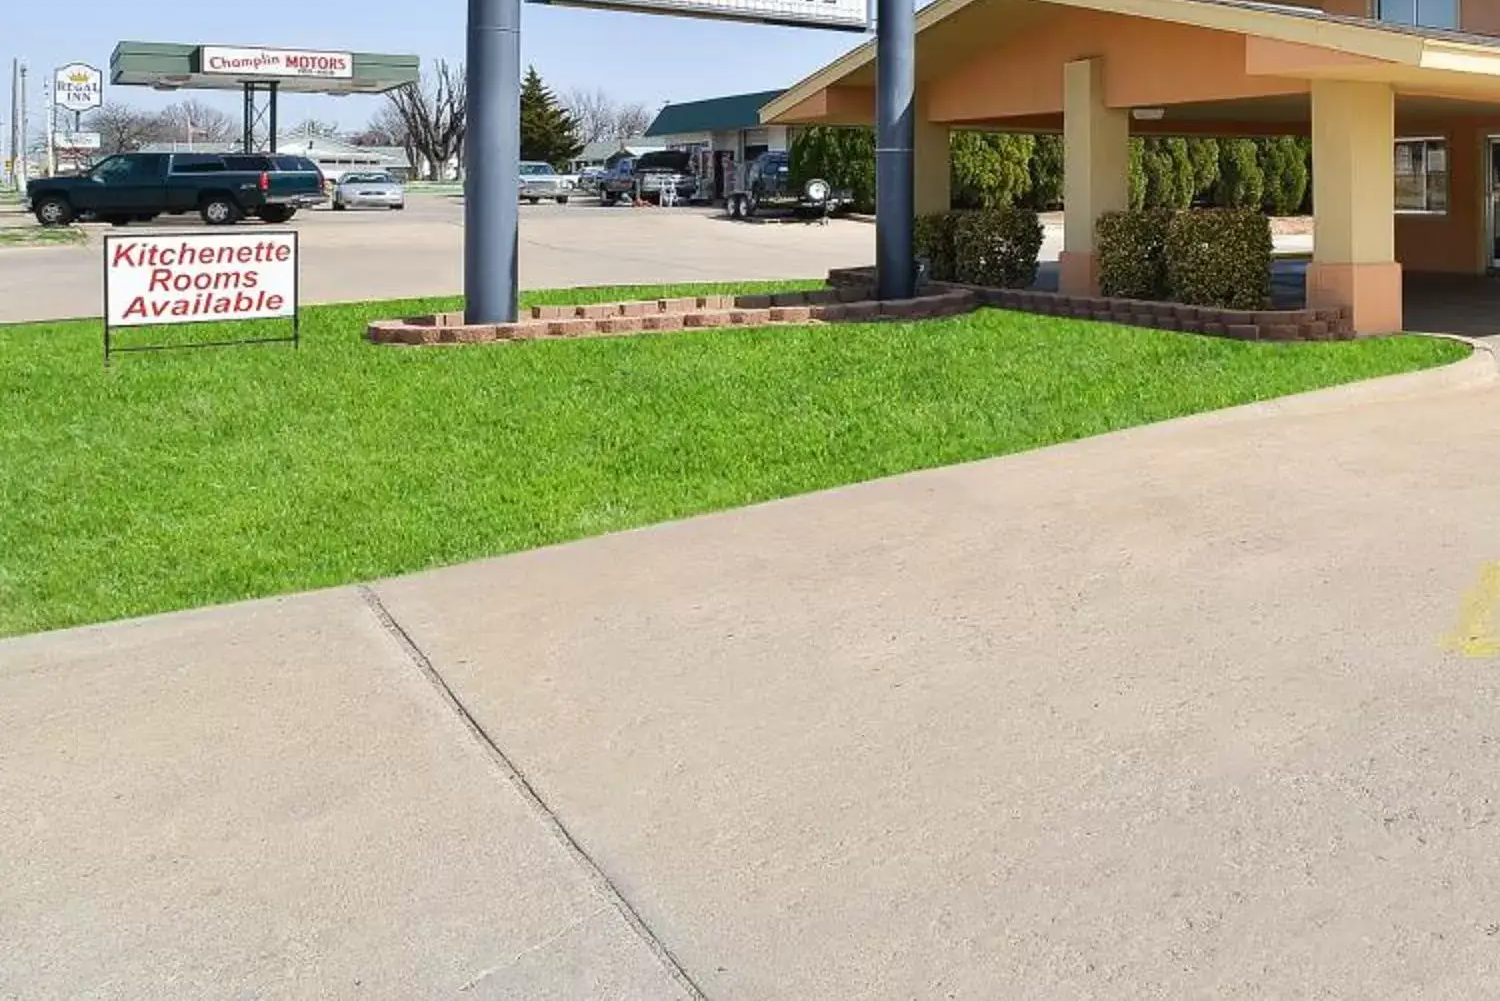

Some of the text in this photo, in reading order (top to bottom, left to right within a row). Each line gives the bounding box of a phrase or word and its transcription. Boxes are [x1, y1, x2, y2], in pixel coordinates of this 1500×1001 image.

[209, 53, 347, 71] Champlin MOTORS
[67, 92, 91, 102] INN
[112, 242, 291, 268] Kitchenette
[149, 268, 258, 292] Rooms
[122, 290, 284, 319] Available
